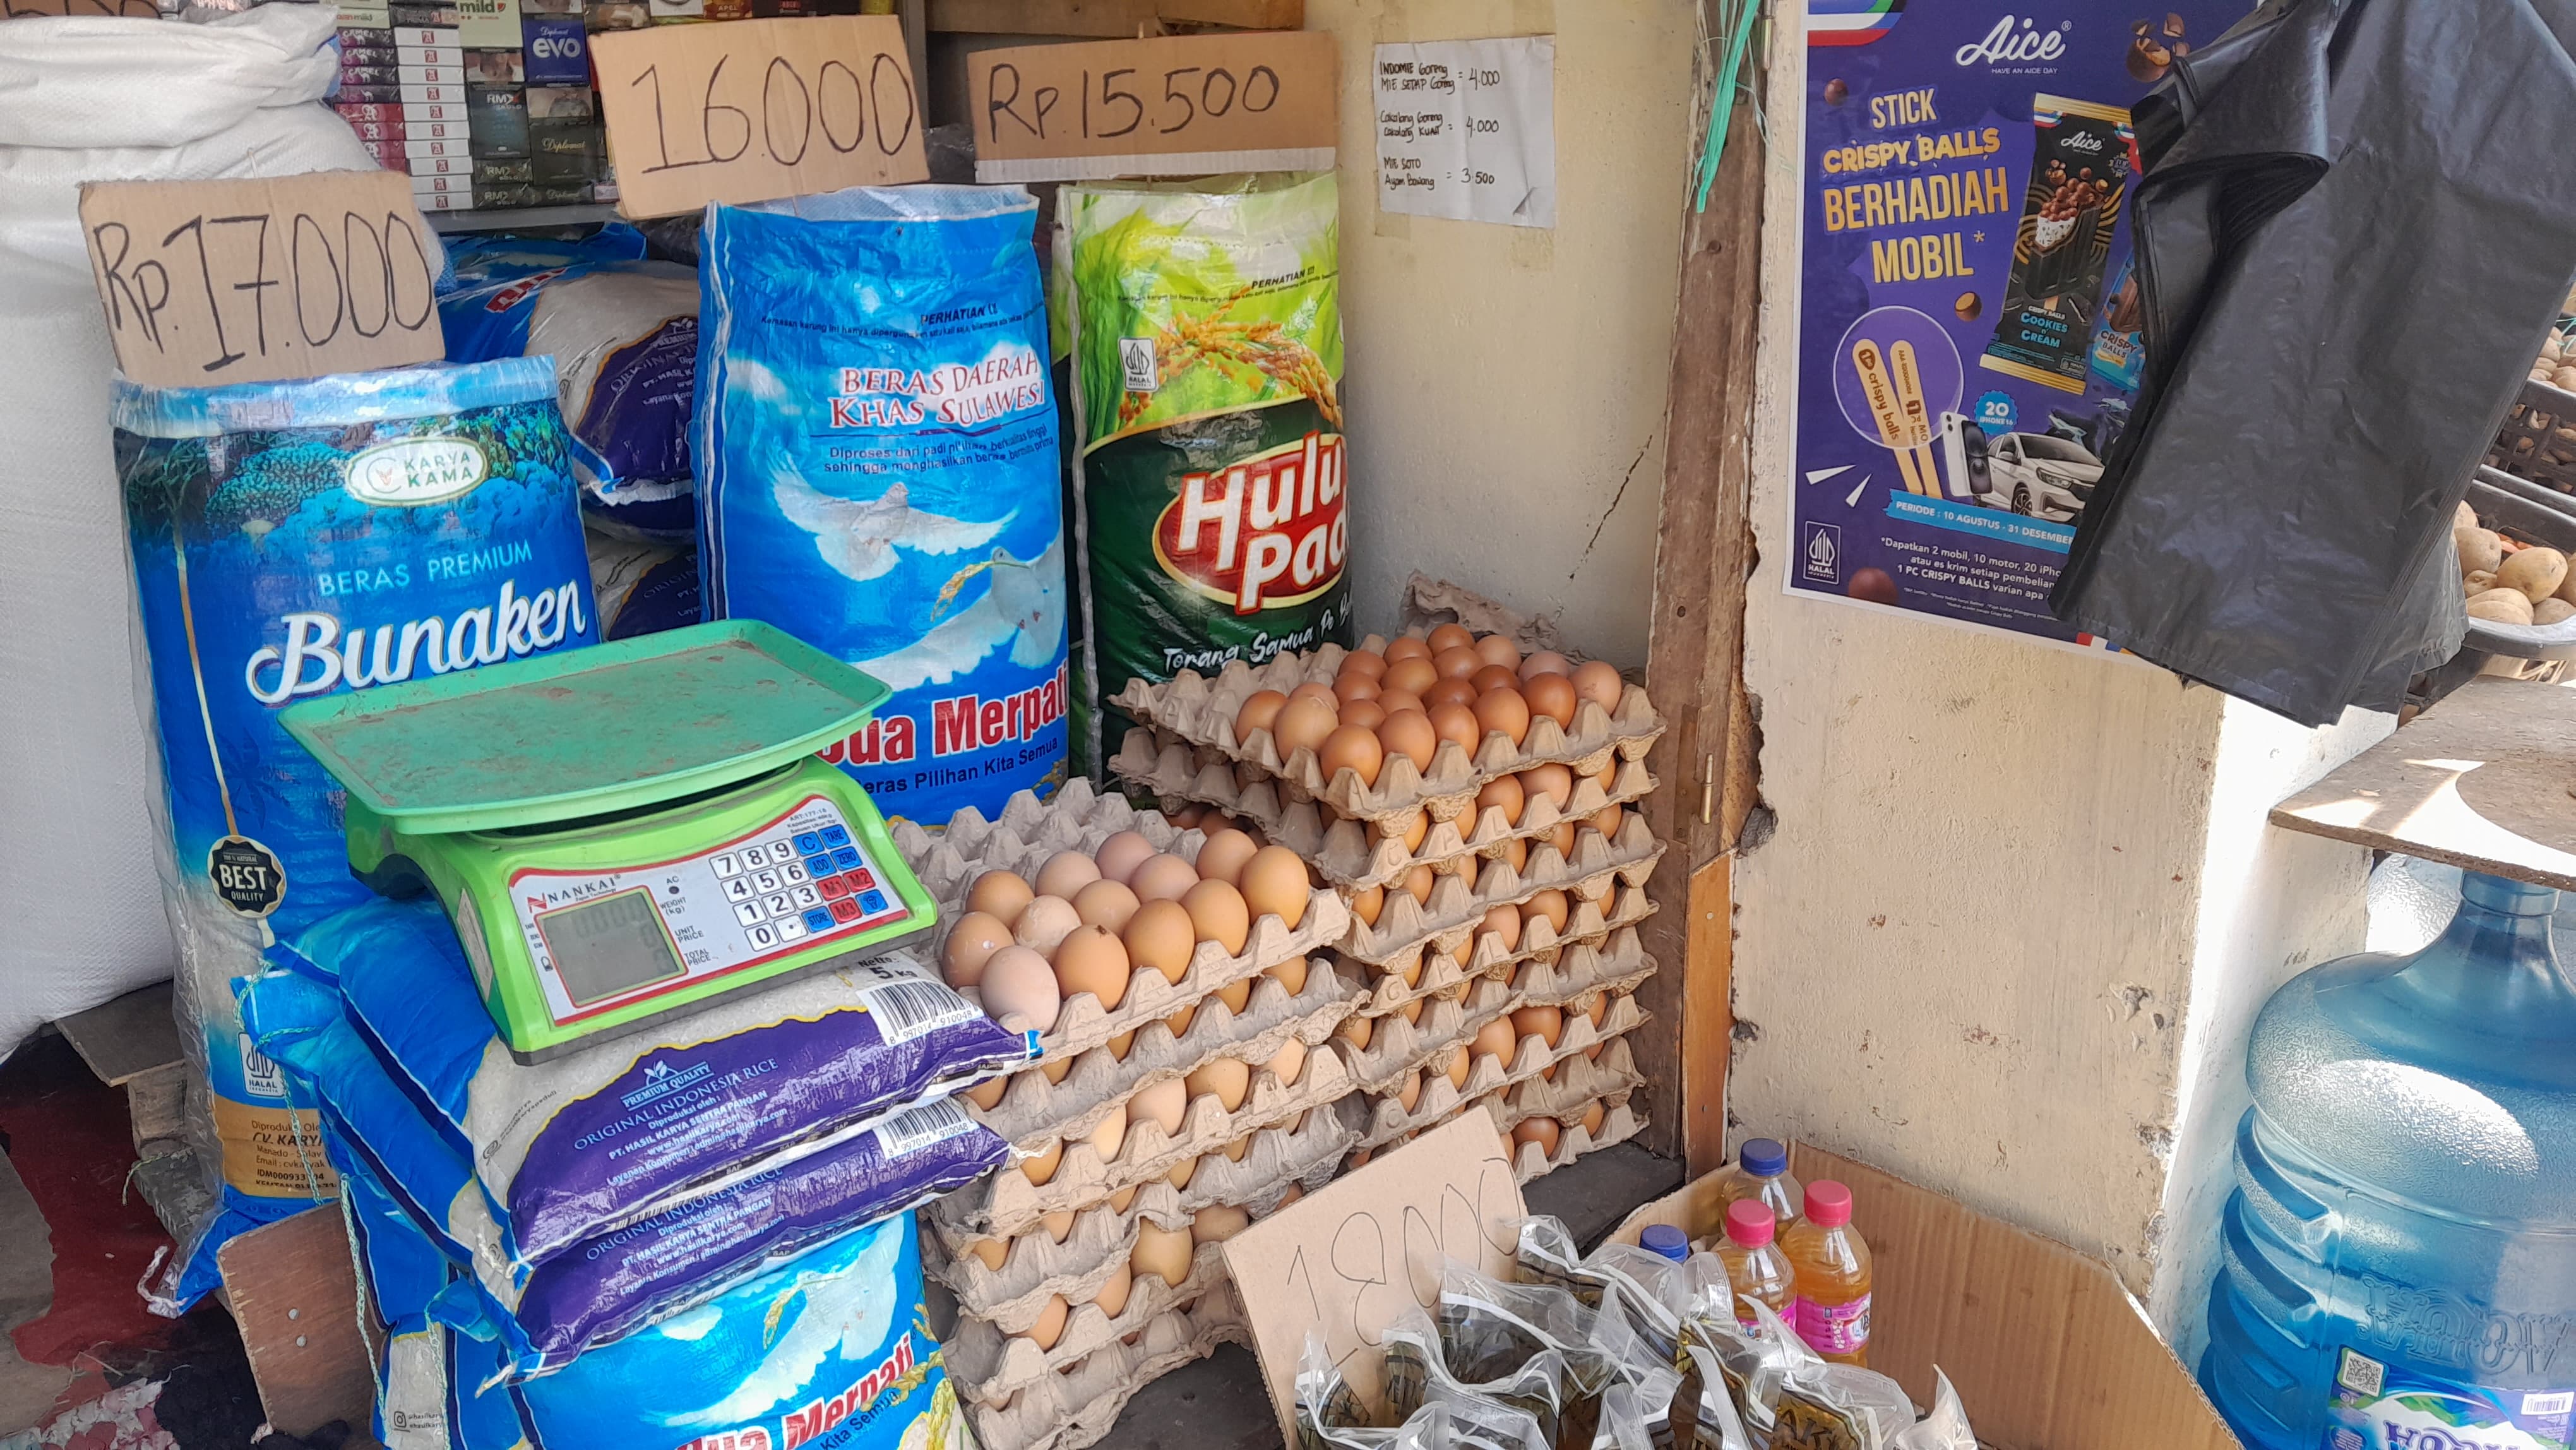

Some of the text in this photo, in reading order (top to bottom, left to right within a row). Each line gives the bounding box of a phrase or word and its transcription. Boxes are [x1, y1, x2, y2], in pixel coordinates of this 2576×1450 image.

[532, 37, 581, 59] evo
[1469, 67, 1501, 90] 4.000
[1870, 87, 1938, 129] STICK
[1465, 116, 1500, 138] 4.000
[541, 137, 587, 153] Diplomat
[1823, 126, 2001, 174] CRISPY BALLS
[1402, 158, 1421, 169] SOTO
[1460, 167, 1495, 184] 3.500
[1825, 166, 2010, 232] BERHADIAH
[1251, 268, 1306, 289] PERHATIAN
[2020, 311, 2069, 333] COOKIES
[2020, 329, 2061, 349] CREAM
[2100, 330, 2138, 354] CRISPY
[2101, 342, 2128, 358] BALLS
[844, 351, 1039, 396] BERAS DAERAH
[829, 379, 1046, 428] KHAS SULAWESI
[1868, 372, 1901, 441] crispy balls
[1984, 401, 2010, 417] 20
[402, 450, 472, 470] KARYA
[829, 443, 946, 460] Diproses dari padi
[406, 467, 475, 489] KAMA
[823, 455, 974, 475] sehingga menghasilkan
[1176, 431, 1343, 573] Hulu
[1895, 501, 2020, 534] PERIODE 10 AGUSTUS 31
[319, 538, 534, 599] BERAS PREMIUM
[1808, 564, 1835, 575] HALAL
[1910, 556, 2001, 582] atau es krim setiap
[1932, 546, 1939, 554] 2
[1940, 548, 1971, 563] mobil,
[1974, 554, 1987, 564] 10
[1988, 558, 2021, 572] motor,
[2024, 562, 2037, 573] 20
[1897, 564, 2044, 601] 1 PC CRISPY BALLS varian apa
[244, 578, 587, 705] Bunaken
[1249, 628, 1315, 664] Samua
[933, 657, 1069, 757] Merpati
[914, 737, 1058, 790] Pilihan Kita Semua
[717, 828, 845, 873] 7 8 9 C TARE
[218, 863, 267, 891] BEST
[666, 875, 679, 884] AC
[732, 851, 857, 896] 4 5 6 ADD ZERO
[230, 890, 264, 902] QUALITY
[589, 887, 617, 899] Technology
[660, 896, 688, 910] WEIGHT
[744, 870, 871, 920] 1 2 3 M1 M2
[674, 925, 695, 937] UNIT
[756, 901, 857, 945] 0 STORE M3
[677, 930, 705, 944] PRICE
[684, 948, 710, 961] TOTAL
[688, 954, 712, 967] PRICE
[871, 967, 918, 980] 5 kg
[889, 1010, 973, 1045] 8 997014 910048
[249, 1079, 278, 1089] HALAL
[621, 1064, 712, 1108] PREMIUM QUALITY
[573, 1110, 654, 1151] ORIGINAL
[655, 1074, 742, 1117] INDONESIA
[744, 1058, 780, 1078] RICE
[647, 1098, 717, 1130] Diproduksi oleh
[609, 1090, 769, 1161] PT. HASIL KARYA SENTRA PANGAN
[256, 1144, 289, 1158] Manado
[888, 1122, 969, 1156] 8 997014 910048
[256, 1154, 278, 1166] Email
[606, 1165, 646, 1187] Layanan
[637, 1243, 666, 1261] HASIL
[665, 1228, 698, 1250] KARYA
[697, 1213, 734, 1235] SENTRA
[732, 1196, 773, 1219] PANGAN
[657, 1205, 725, 1237] Diproduksi oleh
[587, 1218, 664, 1262] ORIGINAL
[820, 1389, 900, 1450] Kita Semua
